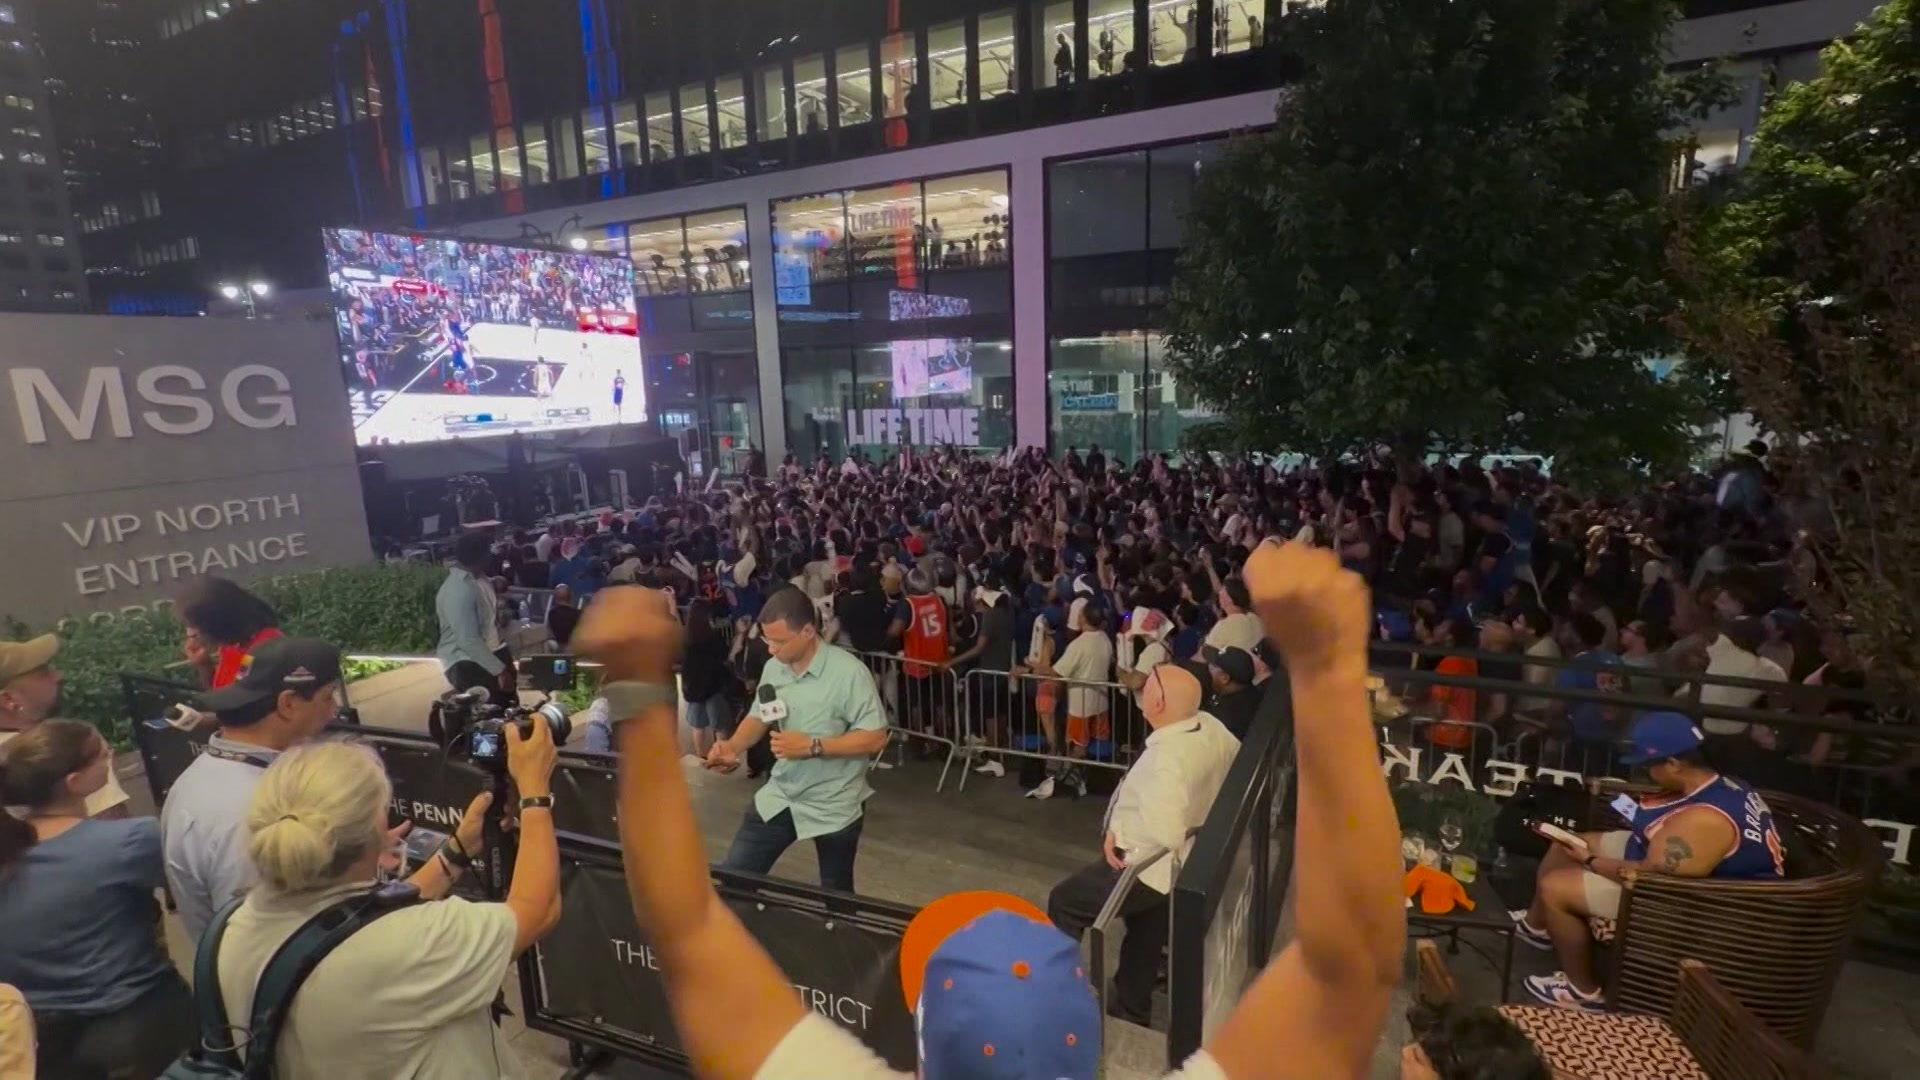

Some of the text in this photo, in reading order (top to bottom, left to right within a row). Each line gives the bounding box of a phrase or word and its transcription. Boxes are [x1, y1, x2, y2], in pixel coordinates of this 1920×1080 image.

[9, 365, 297, 444] MSG
[62, 494, 300, 547] VIP NORTH
[76, 534, 308, 595] ENTRANCE
[922, 613, 942, 637] 15
[389, 798, 464, 825] HE PENN
[611, 938, 873, 1029] THE TRICT
